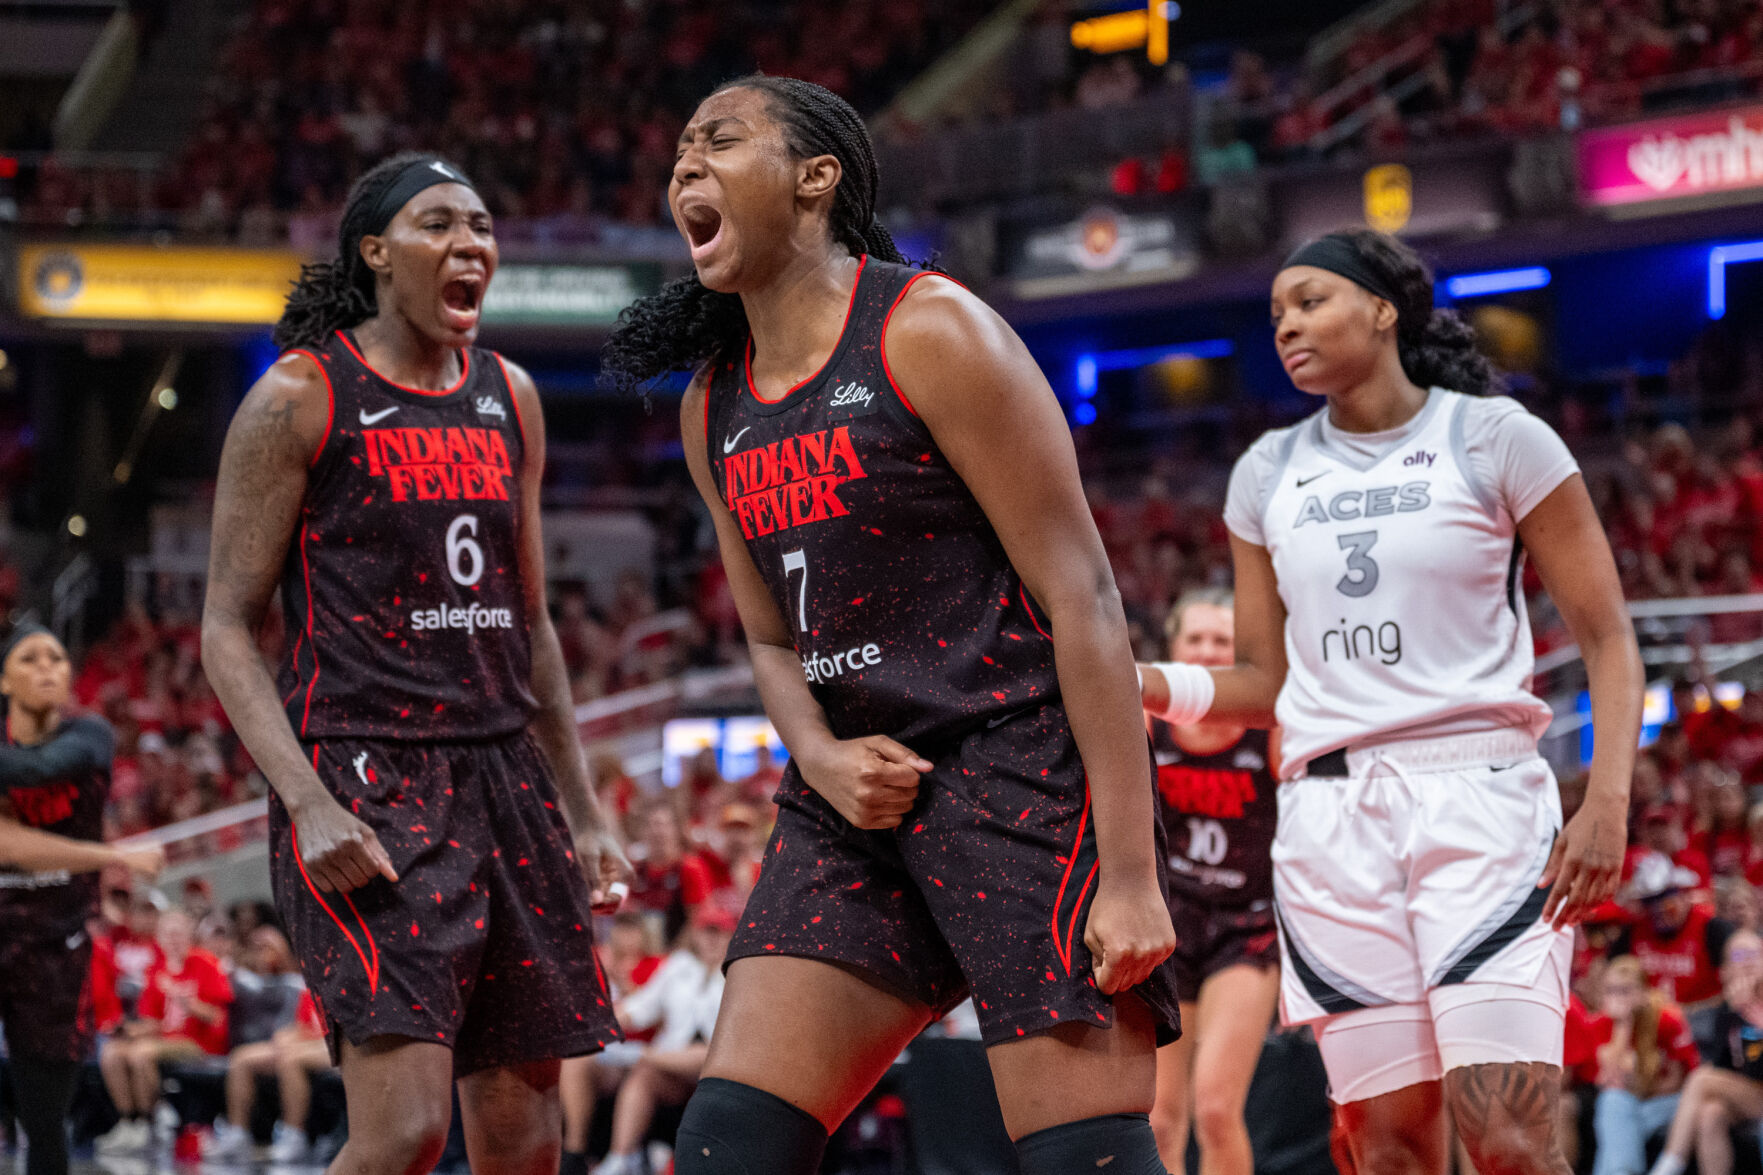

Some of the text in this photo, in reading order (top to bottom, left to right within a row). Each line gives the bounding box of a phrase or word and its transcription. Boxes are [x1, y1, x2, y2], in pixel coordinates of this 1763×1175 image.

[830, 382, 874, 407] Lilly
[361, 426, 512, 477] INDIANA
[724, 425, 867, 511] INDIANA
[1403, 451, 1437, 467] ally
[386, 464, 509, 502] FEVER
[735, 474, 850, 540] FEVER
[1292, 480, 1432, 529] ACES
[445, 514, 484, 586] 6
[1336, 530, 1379, 598] 3
[782, 549, 807, 632] 7
[411, 603, 512, 635] salesforce
[1322, 618, 1401, 666] ring
[1187, 817, 1228, 865] 10
